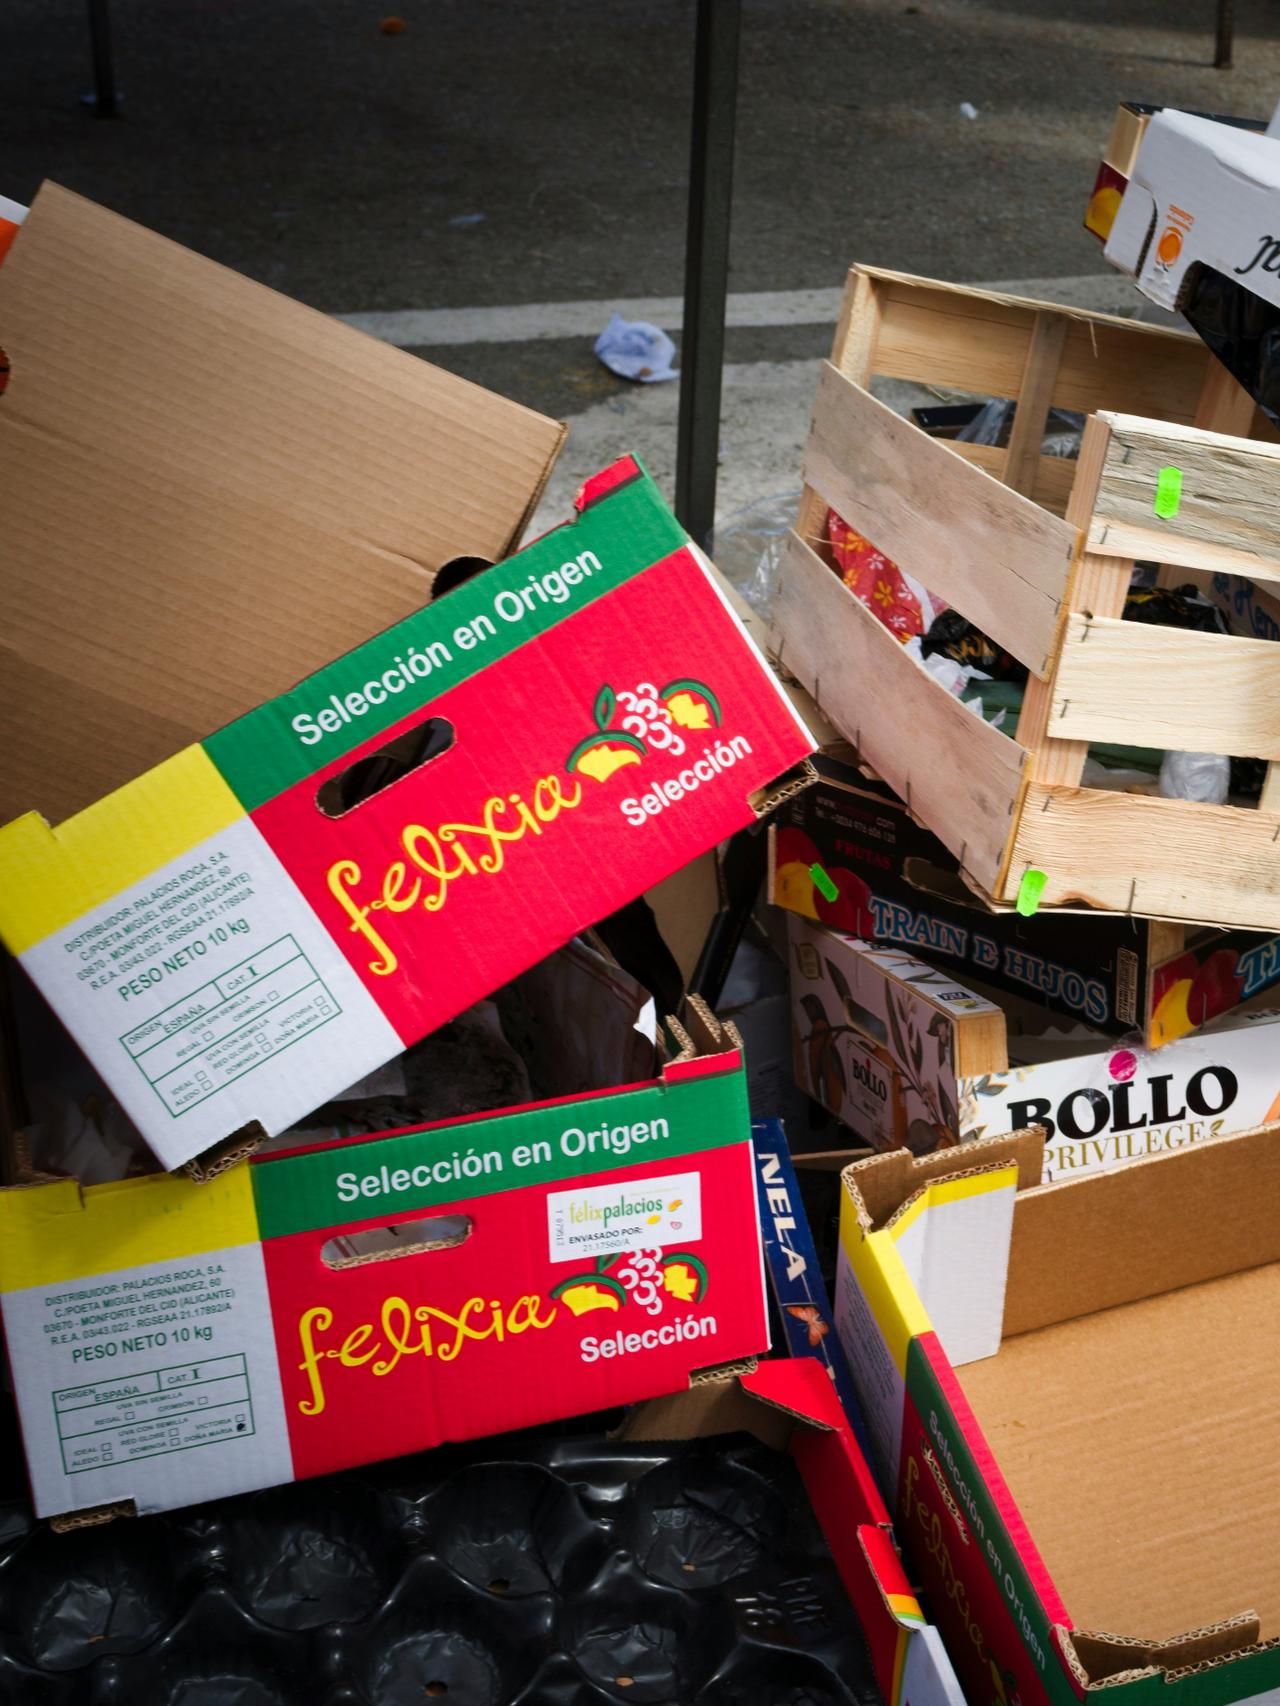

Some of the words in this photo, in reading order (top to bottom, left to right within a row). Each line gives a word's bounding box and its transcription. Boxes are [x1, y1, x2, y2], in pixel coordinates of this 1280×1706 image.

[291, 639, 453, 748] Selección
[453, 617, 498, 662] en
[496, 546, 604, 628] Origen
[620, 732, 752, 828] Selección
[63, 905, 133, 954] DISTRIBUIDOR:
[132, 877, 180, 911] PALACIOS
[208, 848, 229, 866] S.A.
[324, 773, 583, 977] felixia
[109, 923, 163, 961] MONFORTE
[160, 911, 182, 930] DEL
[180, 901, 200, 918] CID
[197, 869, 252, 909] (ALICANTE)
[121, 907, 160, 936] MIGUEL
[117, 965, 165, 1002] PESO
[160, 938, 209, 975] NETO
[205, 925, 230, 948] 10
[225, 913, 252, 939] kg
[868, 896, 967, 959] TRAIN
[974, 936, 1000, 971] E
[1005, 950, 1108, 1024] HIJOS
[126, 1019, 163, 1045] ORIGEN
[161, 1000, 206, 1033] ESPAÑA
[852, 1057, 887, 1101] BOLLO
[1006, 1065, 1238, 1144] BOLLO
[337, 1150, 502, 1204] Selección
[512, 1141, 552, 1167] en
[560, 1116, 670, 1160] Origen
[568, 1229, 619, 1244] ENVASADO
[621, 1225, 643, 1236] POR:
[757, 1153, 808, 1283] NELA
[44, 1283, 120, 1307] DISTRIBUIDOR:
[123, 1273, 171, 1292] PALACIOS
[207, 1263, 226, 1274] S.A.
[80, 1307, 137, 1326] MONFORTE
[138, 1303, 158, 1315] DEL
[159, 1299, 178, 1311] CID
[181, 1287, 235, 1308] (ALICANTE)
[102, 1292, 140, 1308] MIGUEL
[71, 1340, 118, 1365] PESO
[121, 1330, 167, 1354] NETO
[170, 1327, 190, 1344] 10
[193, 1323, 213, 1343] kg
[298, 1292, 558, 1417] felixia
[580, 1313, 718, 1364] Selección
[58, 1385, 95, 1401] ORIGEN
[94, 1383, 140, 1402] ESPAÑA
[929, 1409, 985, 1539] Selección
[986, 1536, 1003, 1574] en
[1003, 1571, 1047, 1671] Origen
